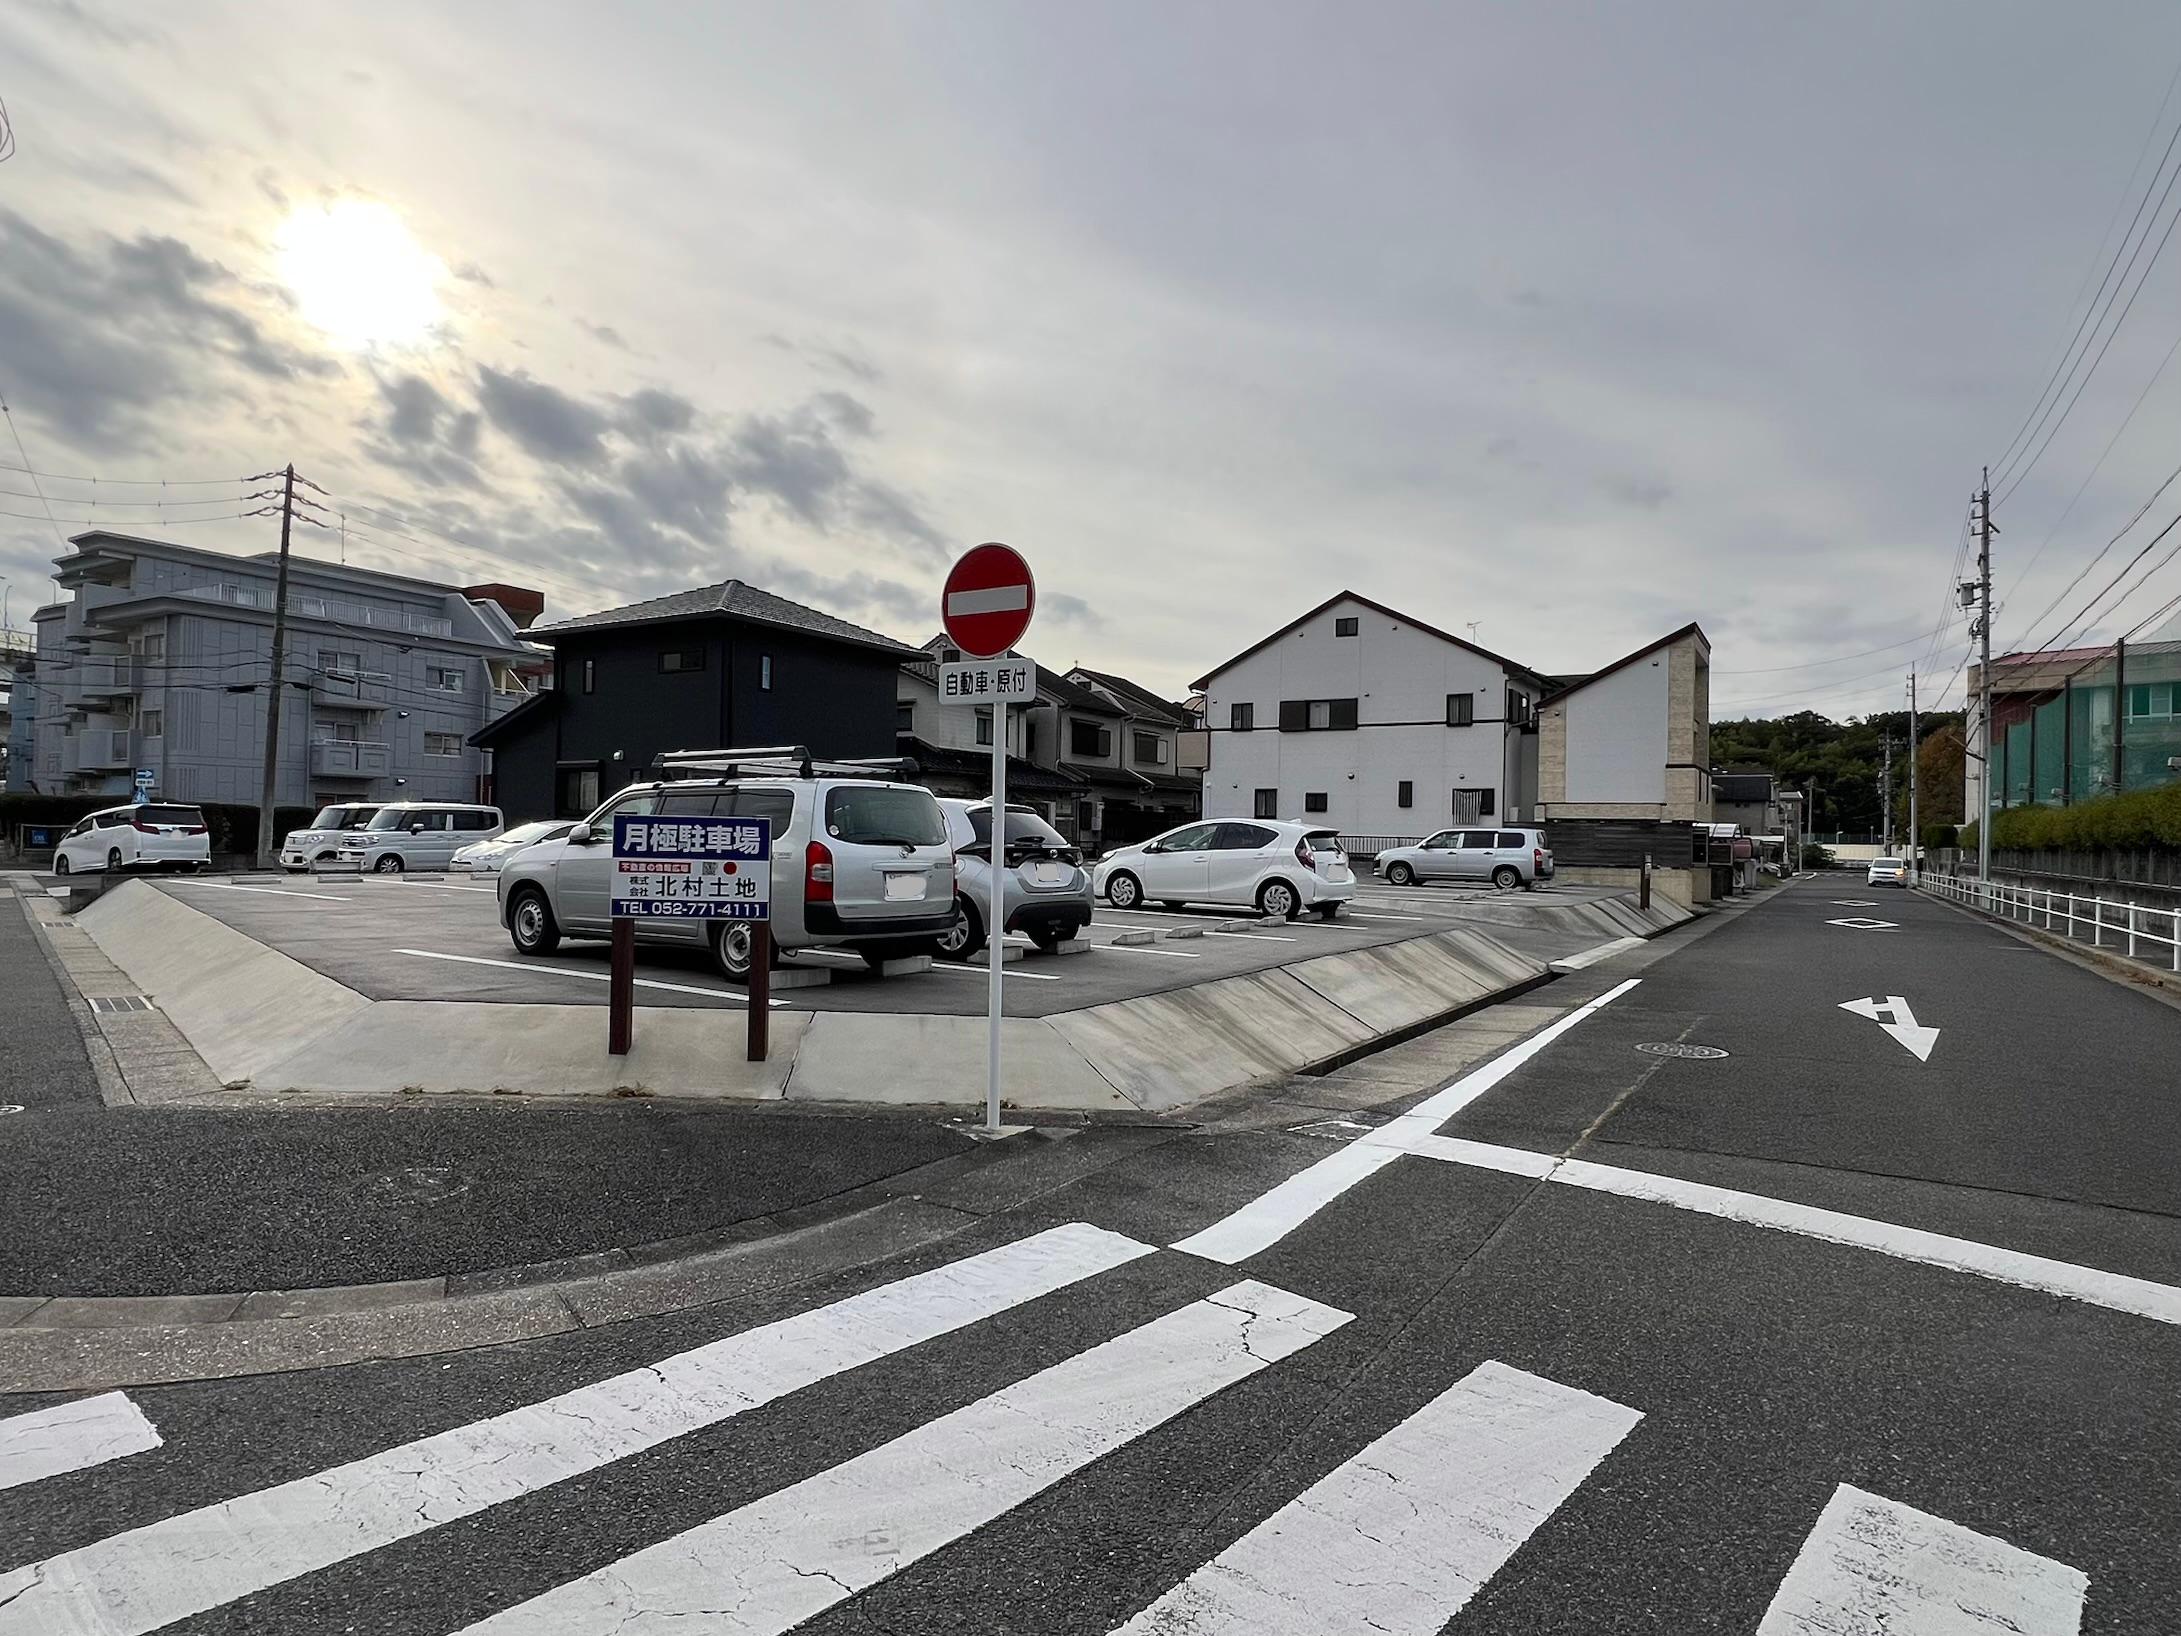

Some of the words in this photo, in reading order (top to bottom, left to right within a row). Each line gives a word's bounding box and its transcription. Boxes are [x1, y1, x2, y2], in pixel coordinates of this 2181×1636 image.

[946, 667, 1027, 696] 自動車・原付
[622, 823, 761, 855] 月極駐車場
[655, 875, 757, 898] 北村土地
[620, 901, 648, 914] TEL
[652, 902, 760, 917] 052-771-4111
